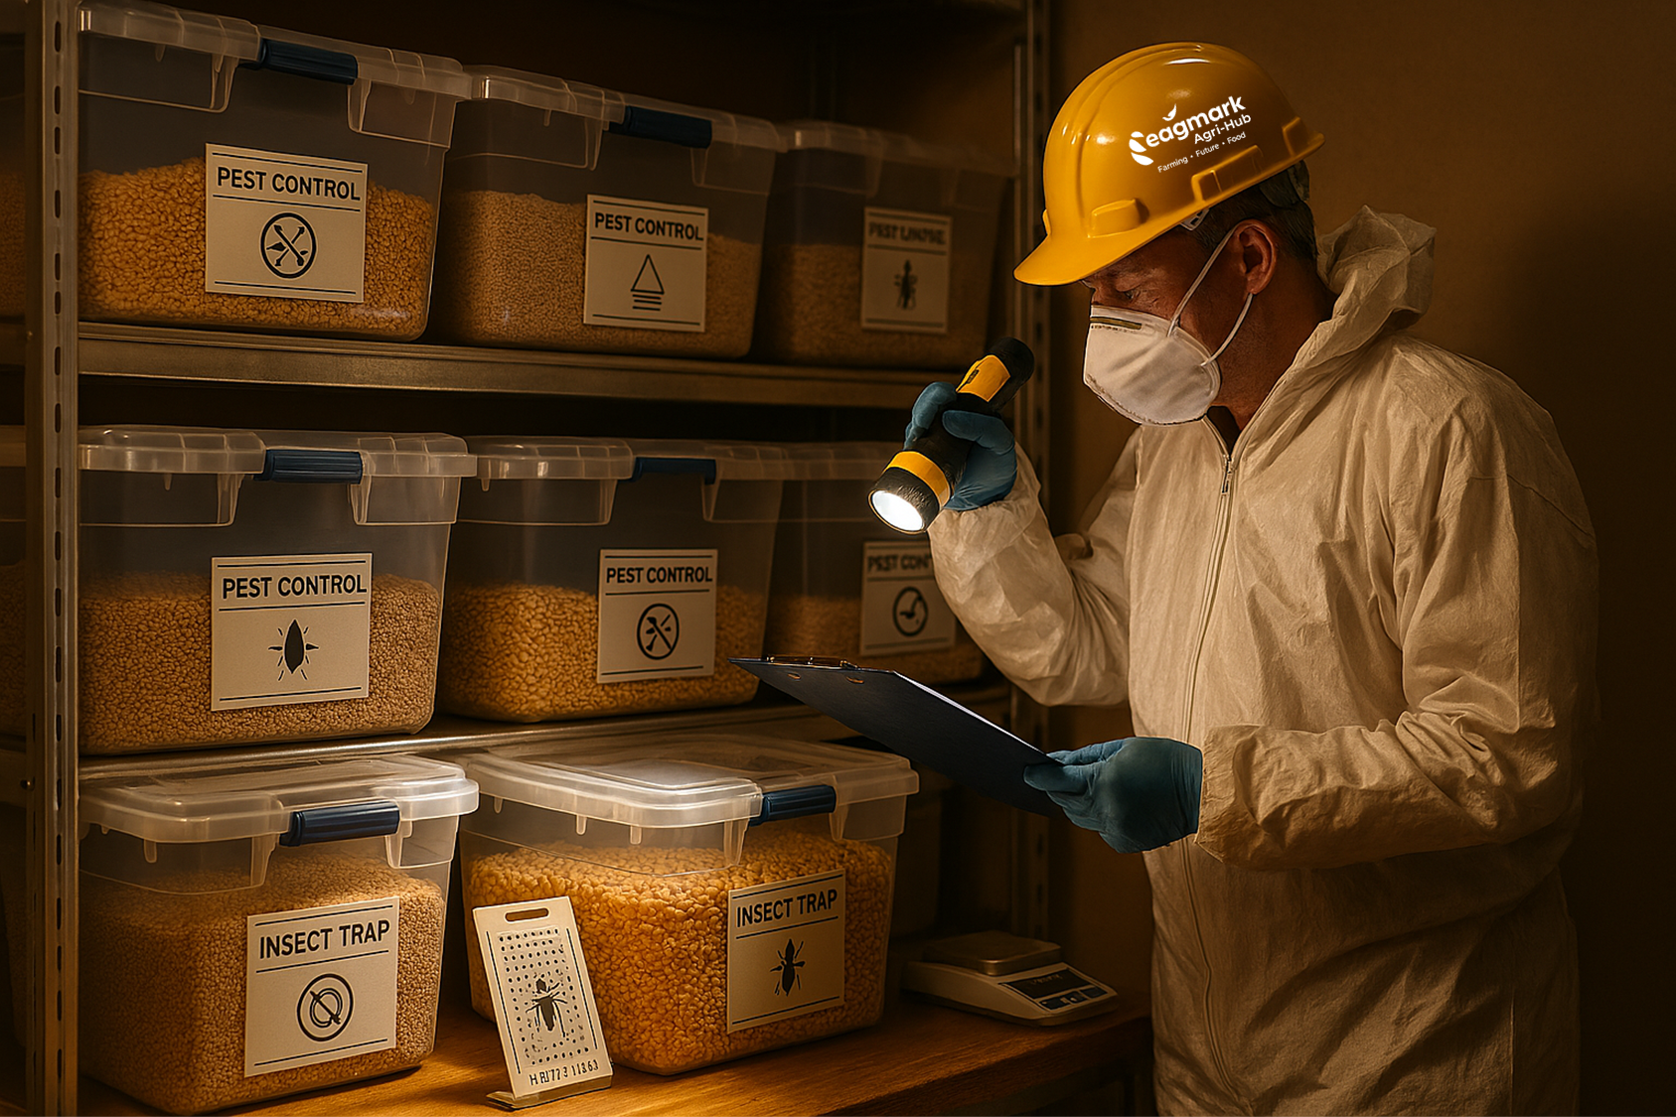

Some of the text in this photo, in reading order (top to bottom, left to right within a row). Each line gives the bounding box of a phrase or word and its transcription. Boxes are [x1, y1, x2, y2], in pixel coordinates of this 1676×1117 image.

[1194, 114, 1252, 144] Agri-Hub
[1157, 131, 1247, 173] Farming Future Food
[217, 167, 361, 201] PEST CONTROL
[595, 212, 704, 241] PEST CONTROL
[223, 574, 367, 599] PEST CONTROL
[606, 566, 713, 583] PEST CONTROL
[737, 889, 837, 927] INSECT TRAP
[260, 920, 390, 959] INSECT TRAP
